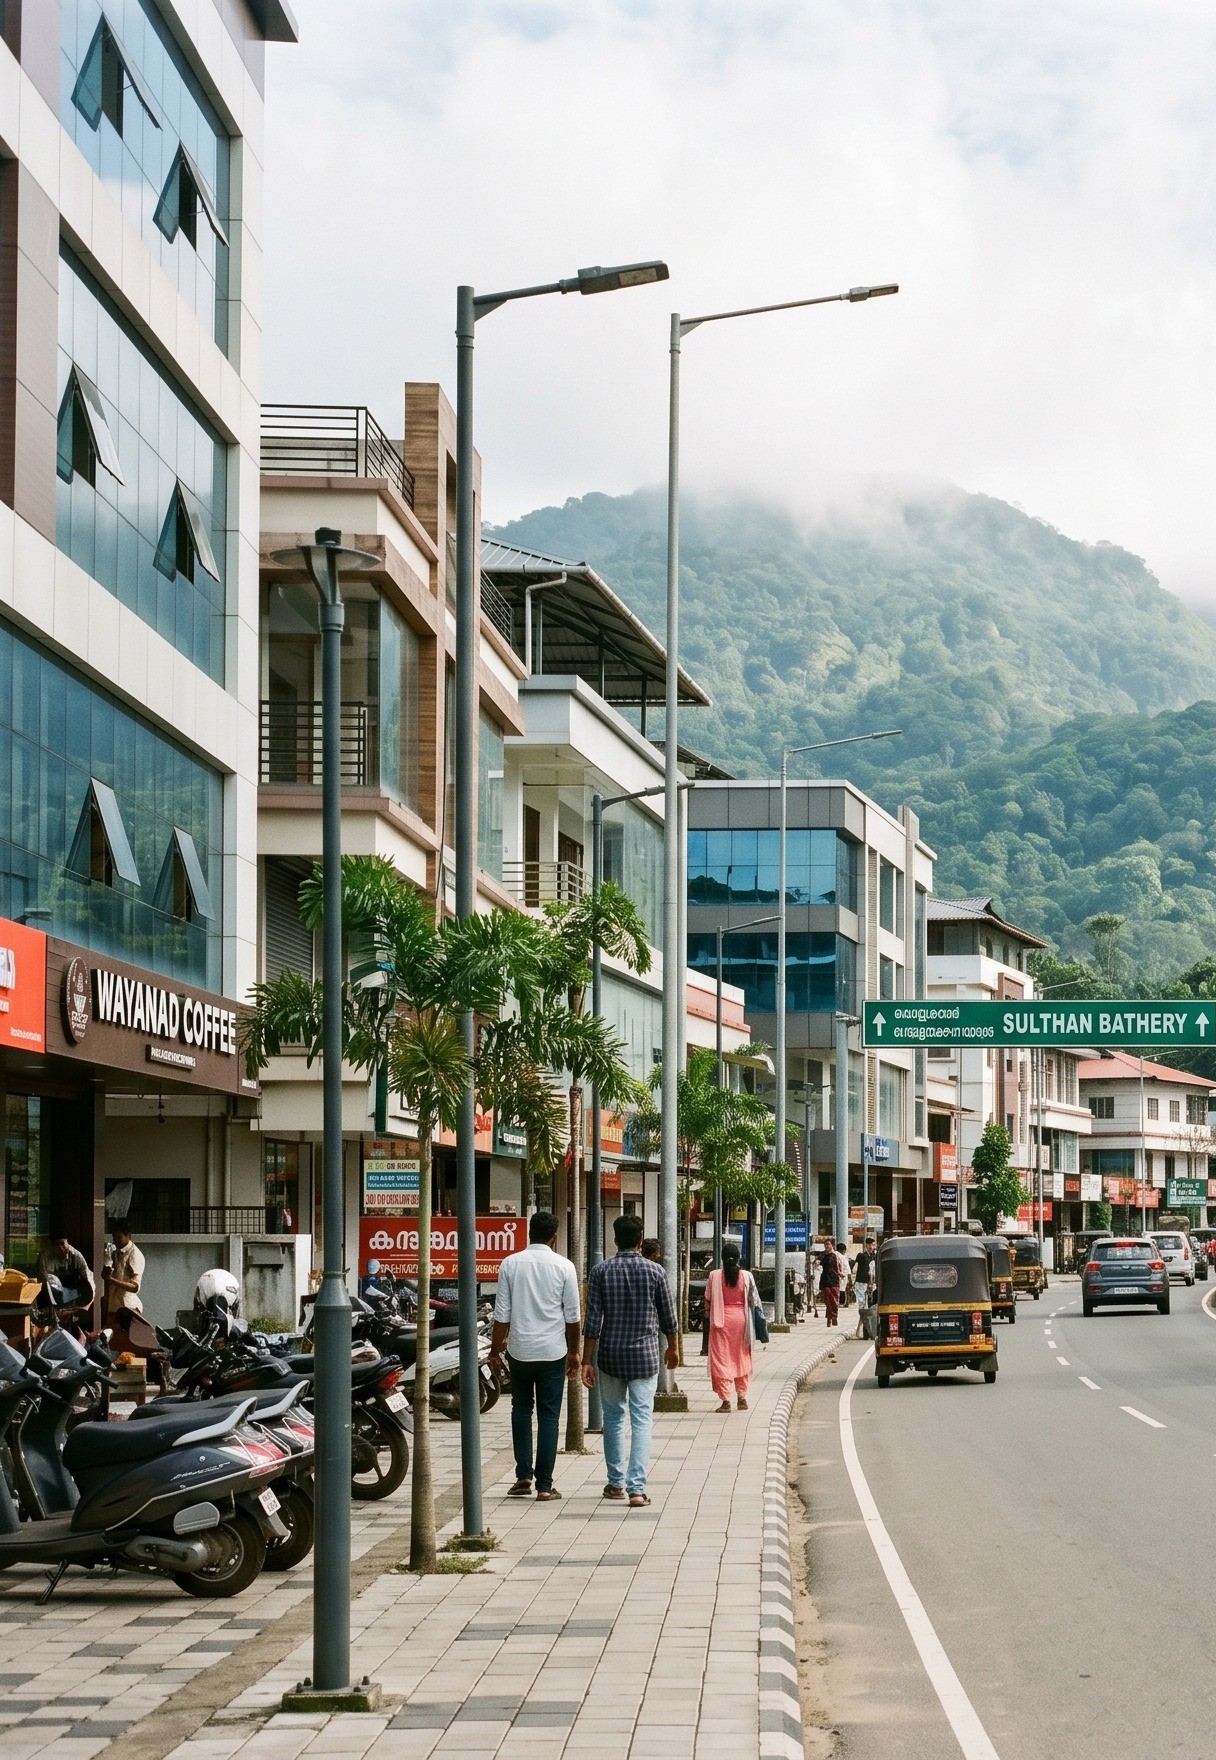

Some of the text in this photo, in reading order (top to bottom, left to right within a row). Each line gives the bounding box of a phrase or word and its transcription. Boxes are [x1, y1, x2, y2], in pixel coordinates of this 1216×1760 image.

[97, 968, 180, 1039] WAYANAD
[183, 997, 237, 1055] COFFEE
[1002, 1012, 1093, 1034] SULTHAN
[1099, 1012, 1188, 1034] BATHERY
